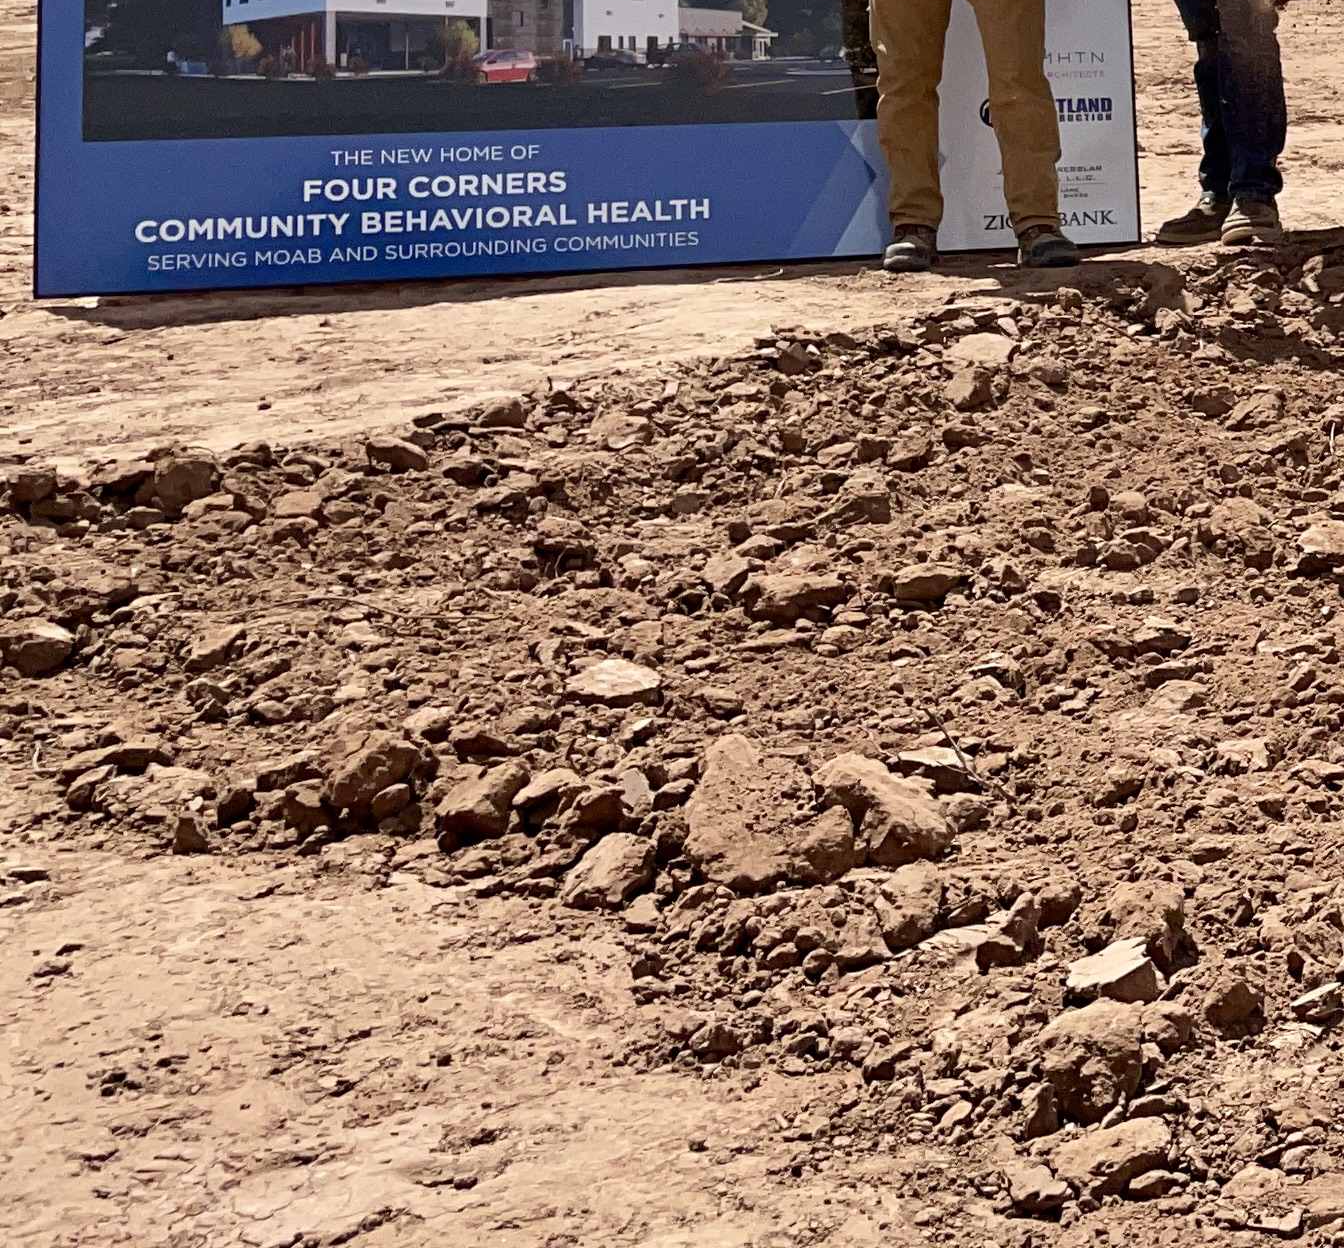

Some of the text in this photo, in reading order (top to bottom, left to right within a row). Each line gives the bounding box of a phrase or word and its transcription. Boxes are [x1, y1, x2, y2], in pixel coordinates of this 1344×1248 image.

[331, 144, 541, 166] THE NEW HOME OF
[303, 171, 568, 203] FOUR CORNERS
[134, 198, 711, 244] COMMUNITY BEHAVIORAL HEALTH
[147, 231, 700, 271] SERVING MOAB AND SURROUNDING COMMUNITIES
